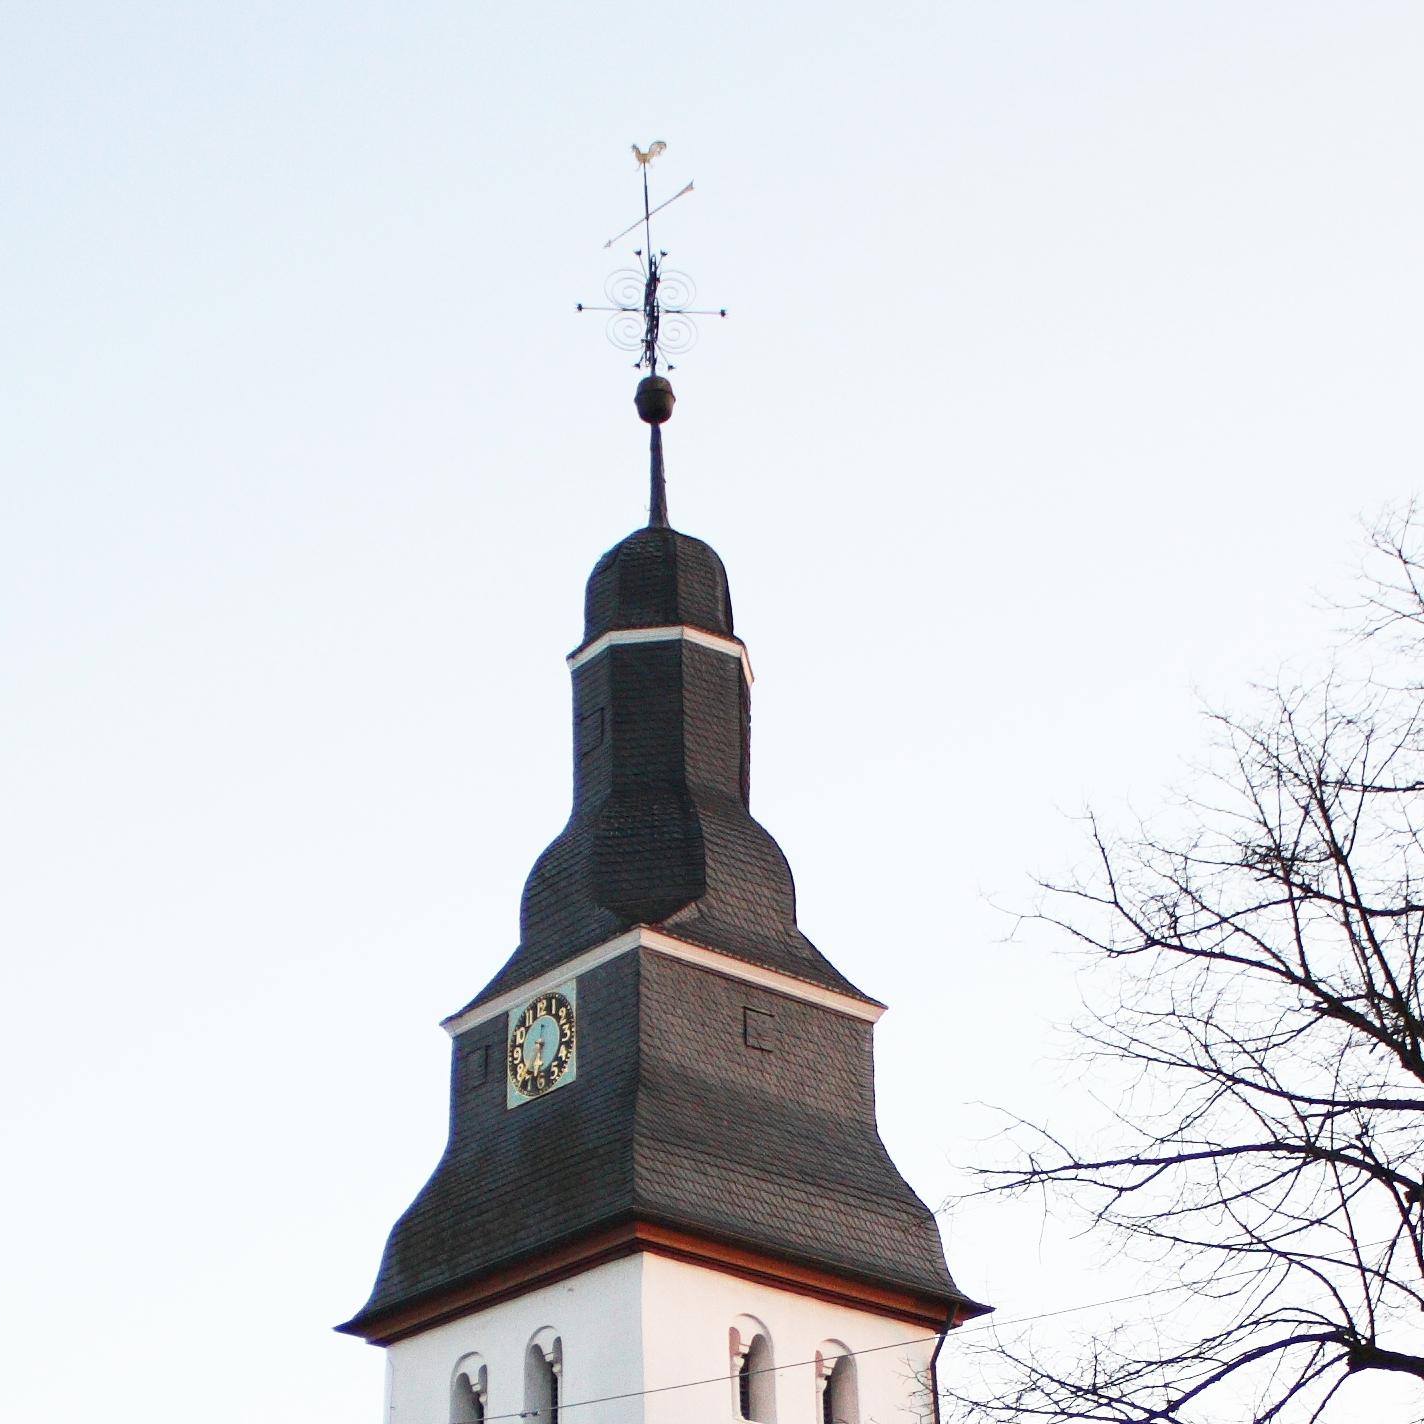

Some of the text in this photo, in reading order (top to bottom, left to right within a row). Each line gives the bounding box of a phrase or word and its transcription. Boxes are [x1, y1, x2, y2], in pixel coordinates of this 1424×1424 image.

[537, 999, 547, 1017] 12
[551, 999, 556, 1014] 1
[525, 1008, 533, 1027] 11
[558, 1006, 567, 1025] 2
[562, 1024, 571, 1041] 3
[513, 1047, 522, 1064] 9
[558, 1045, 567, 1061] 4
[550, 1061, 559, 1079] 5
[536, 1072, 545, 1089] 6
